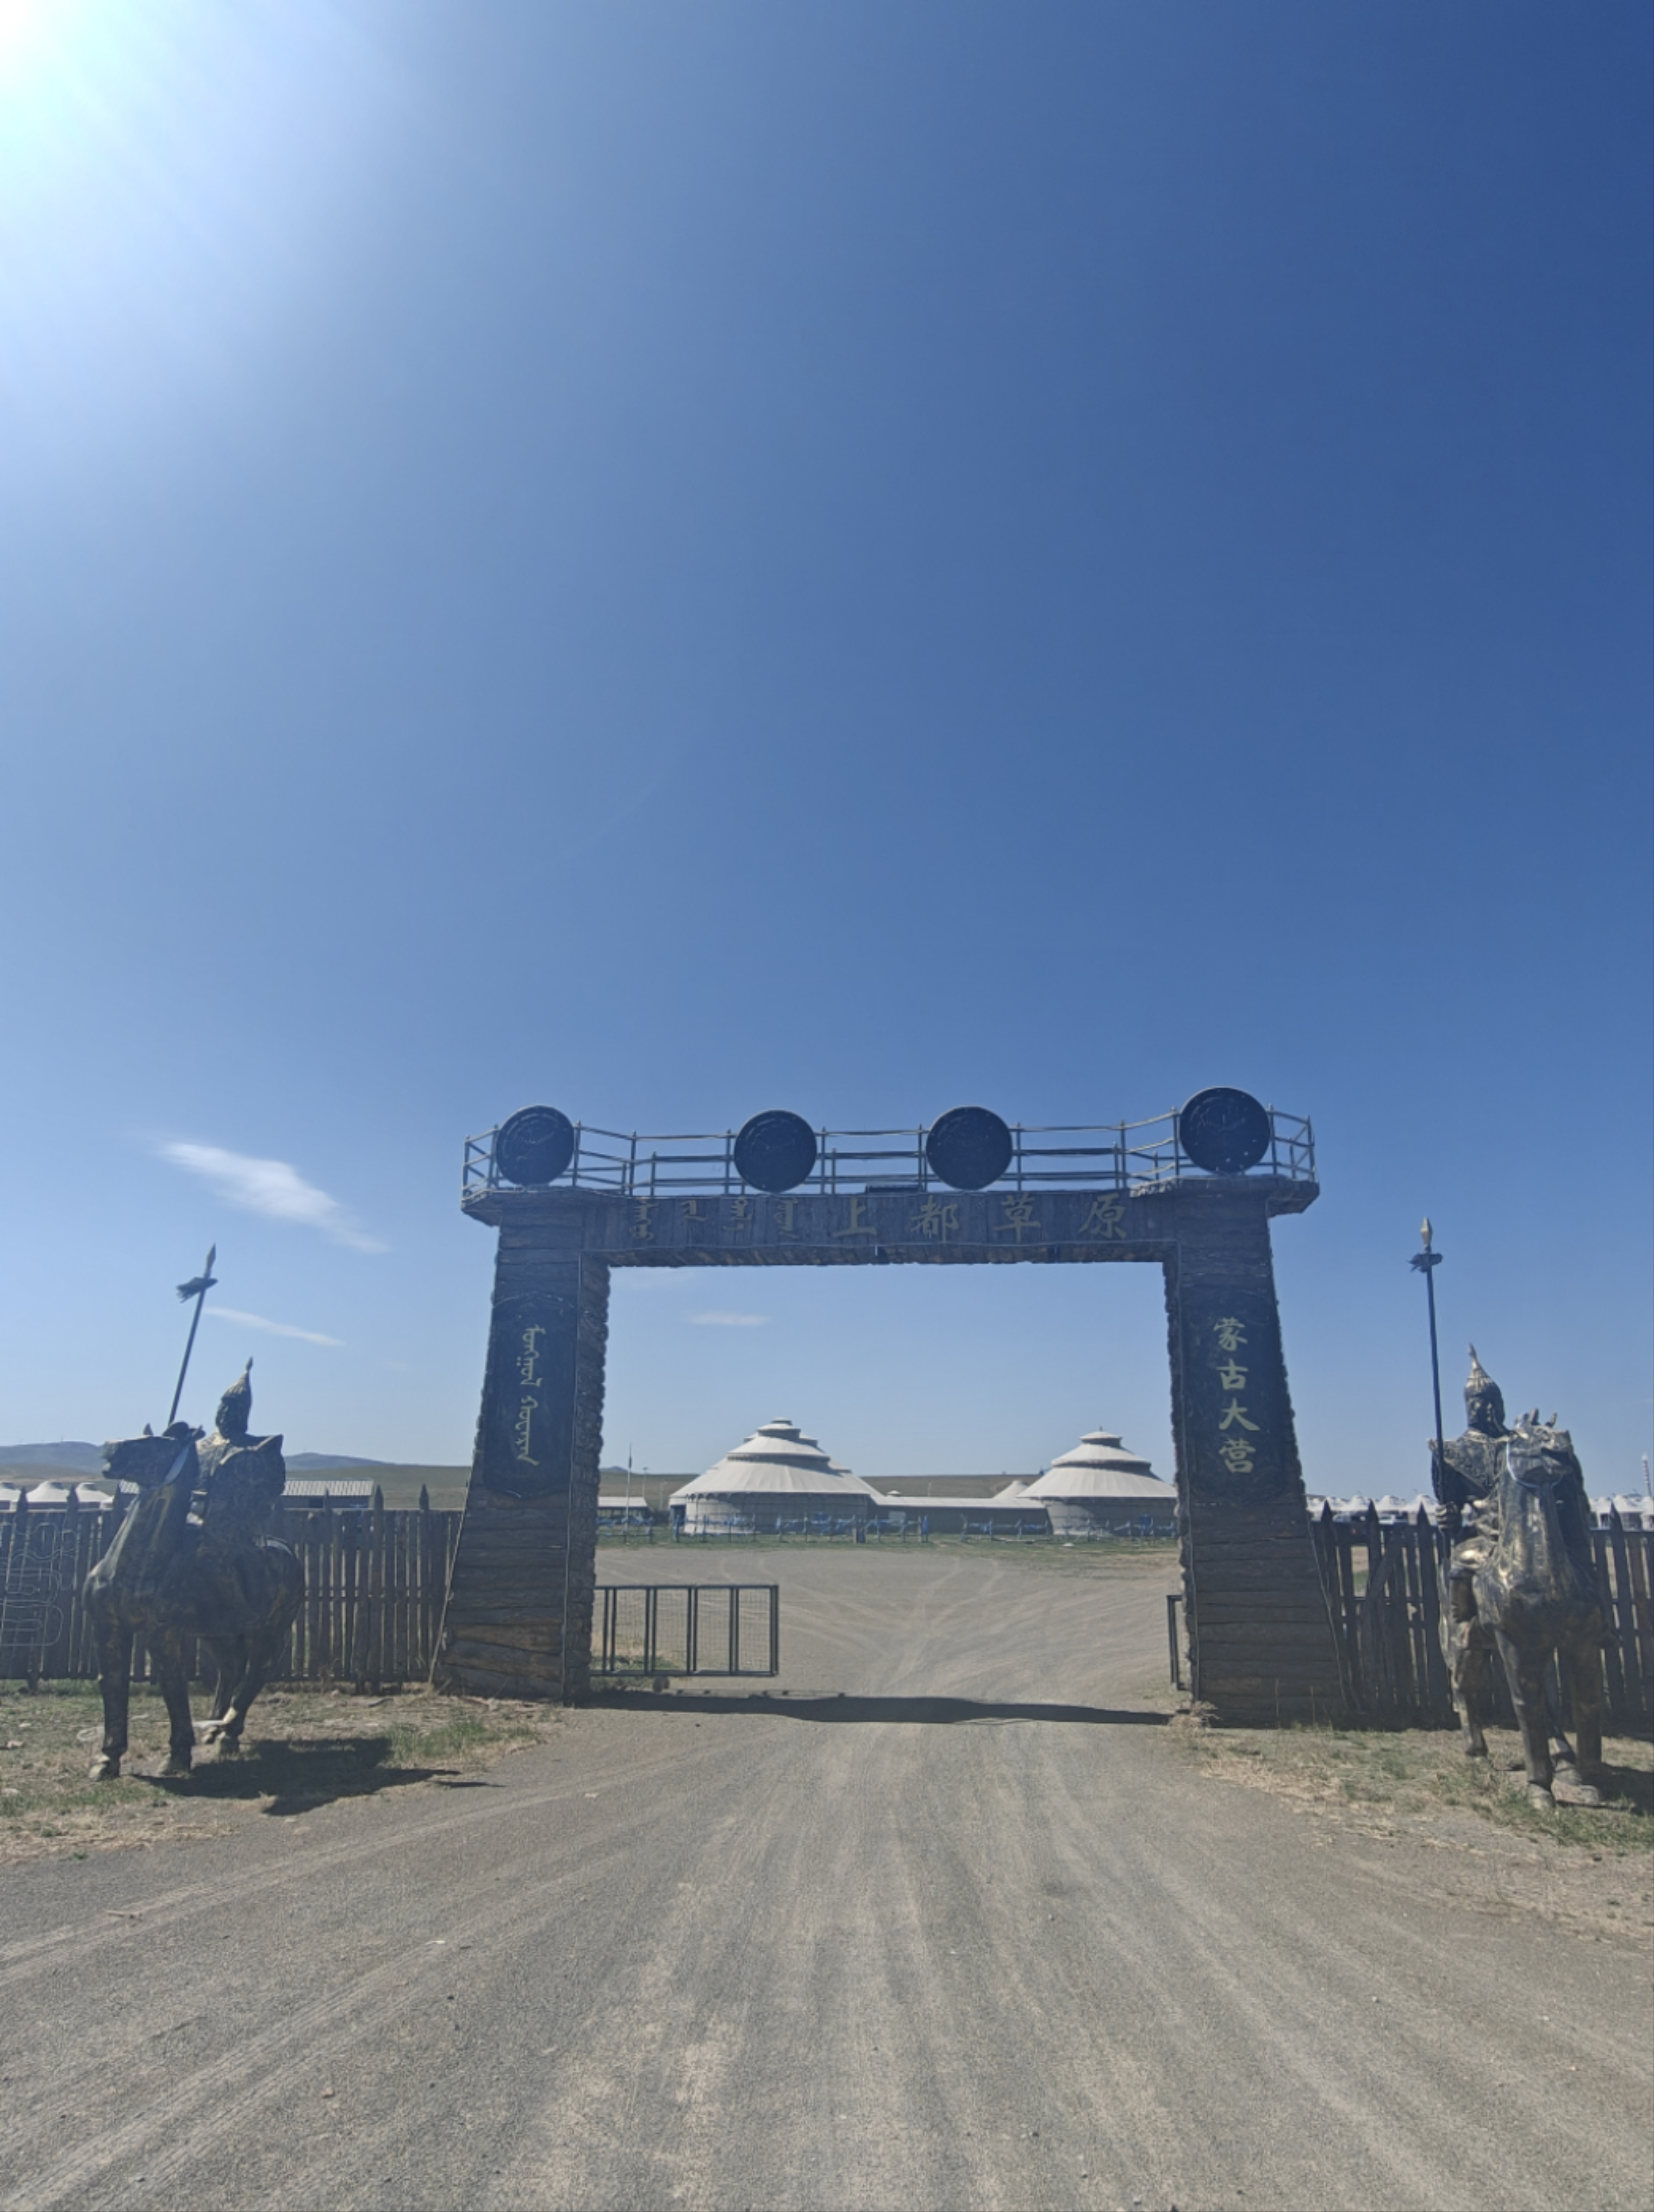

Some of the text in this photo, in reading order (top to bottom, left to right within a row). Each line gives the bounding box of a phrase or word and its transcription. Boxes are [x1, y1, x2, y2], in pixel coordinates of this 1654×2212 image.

[832, 1193, 1127, 1243] 上都草原
[1213, 1317, 1260, 1473] 蒙古大营
